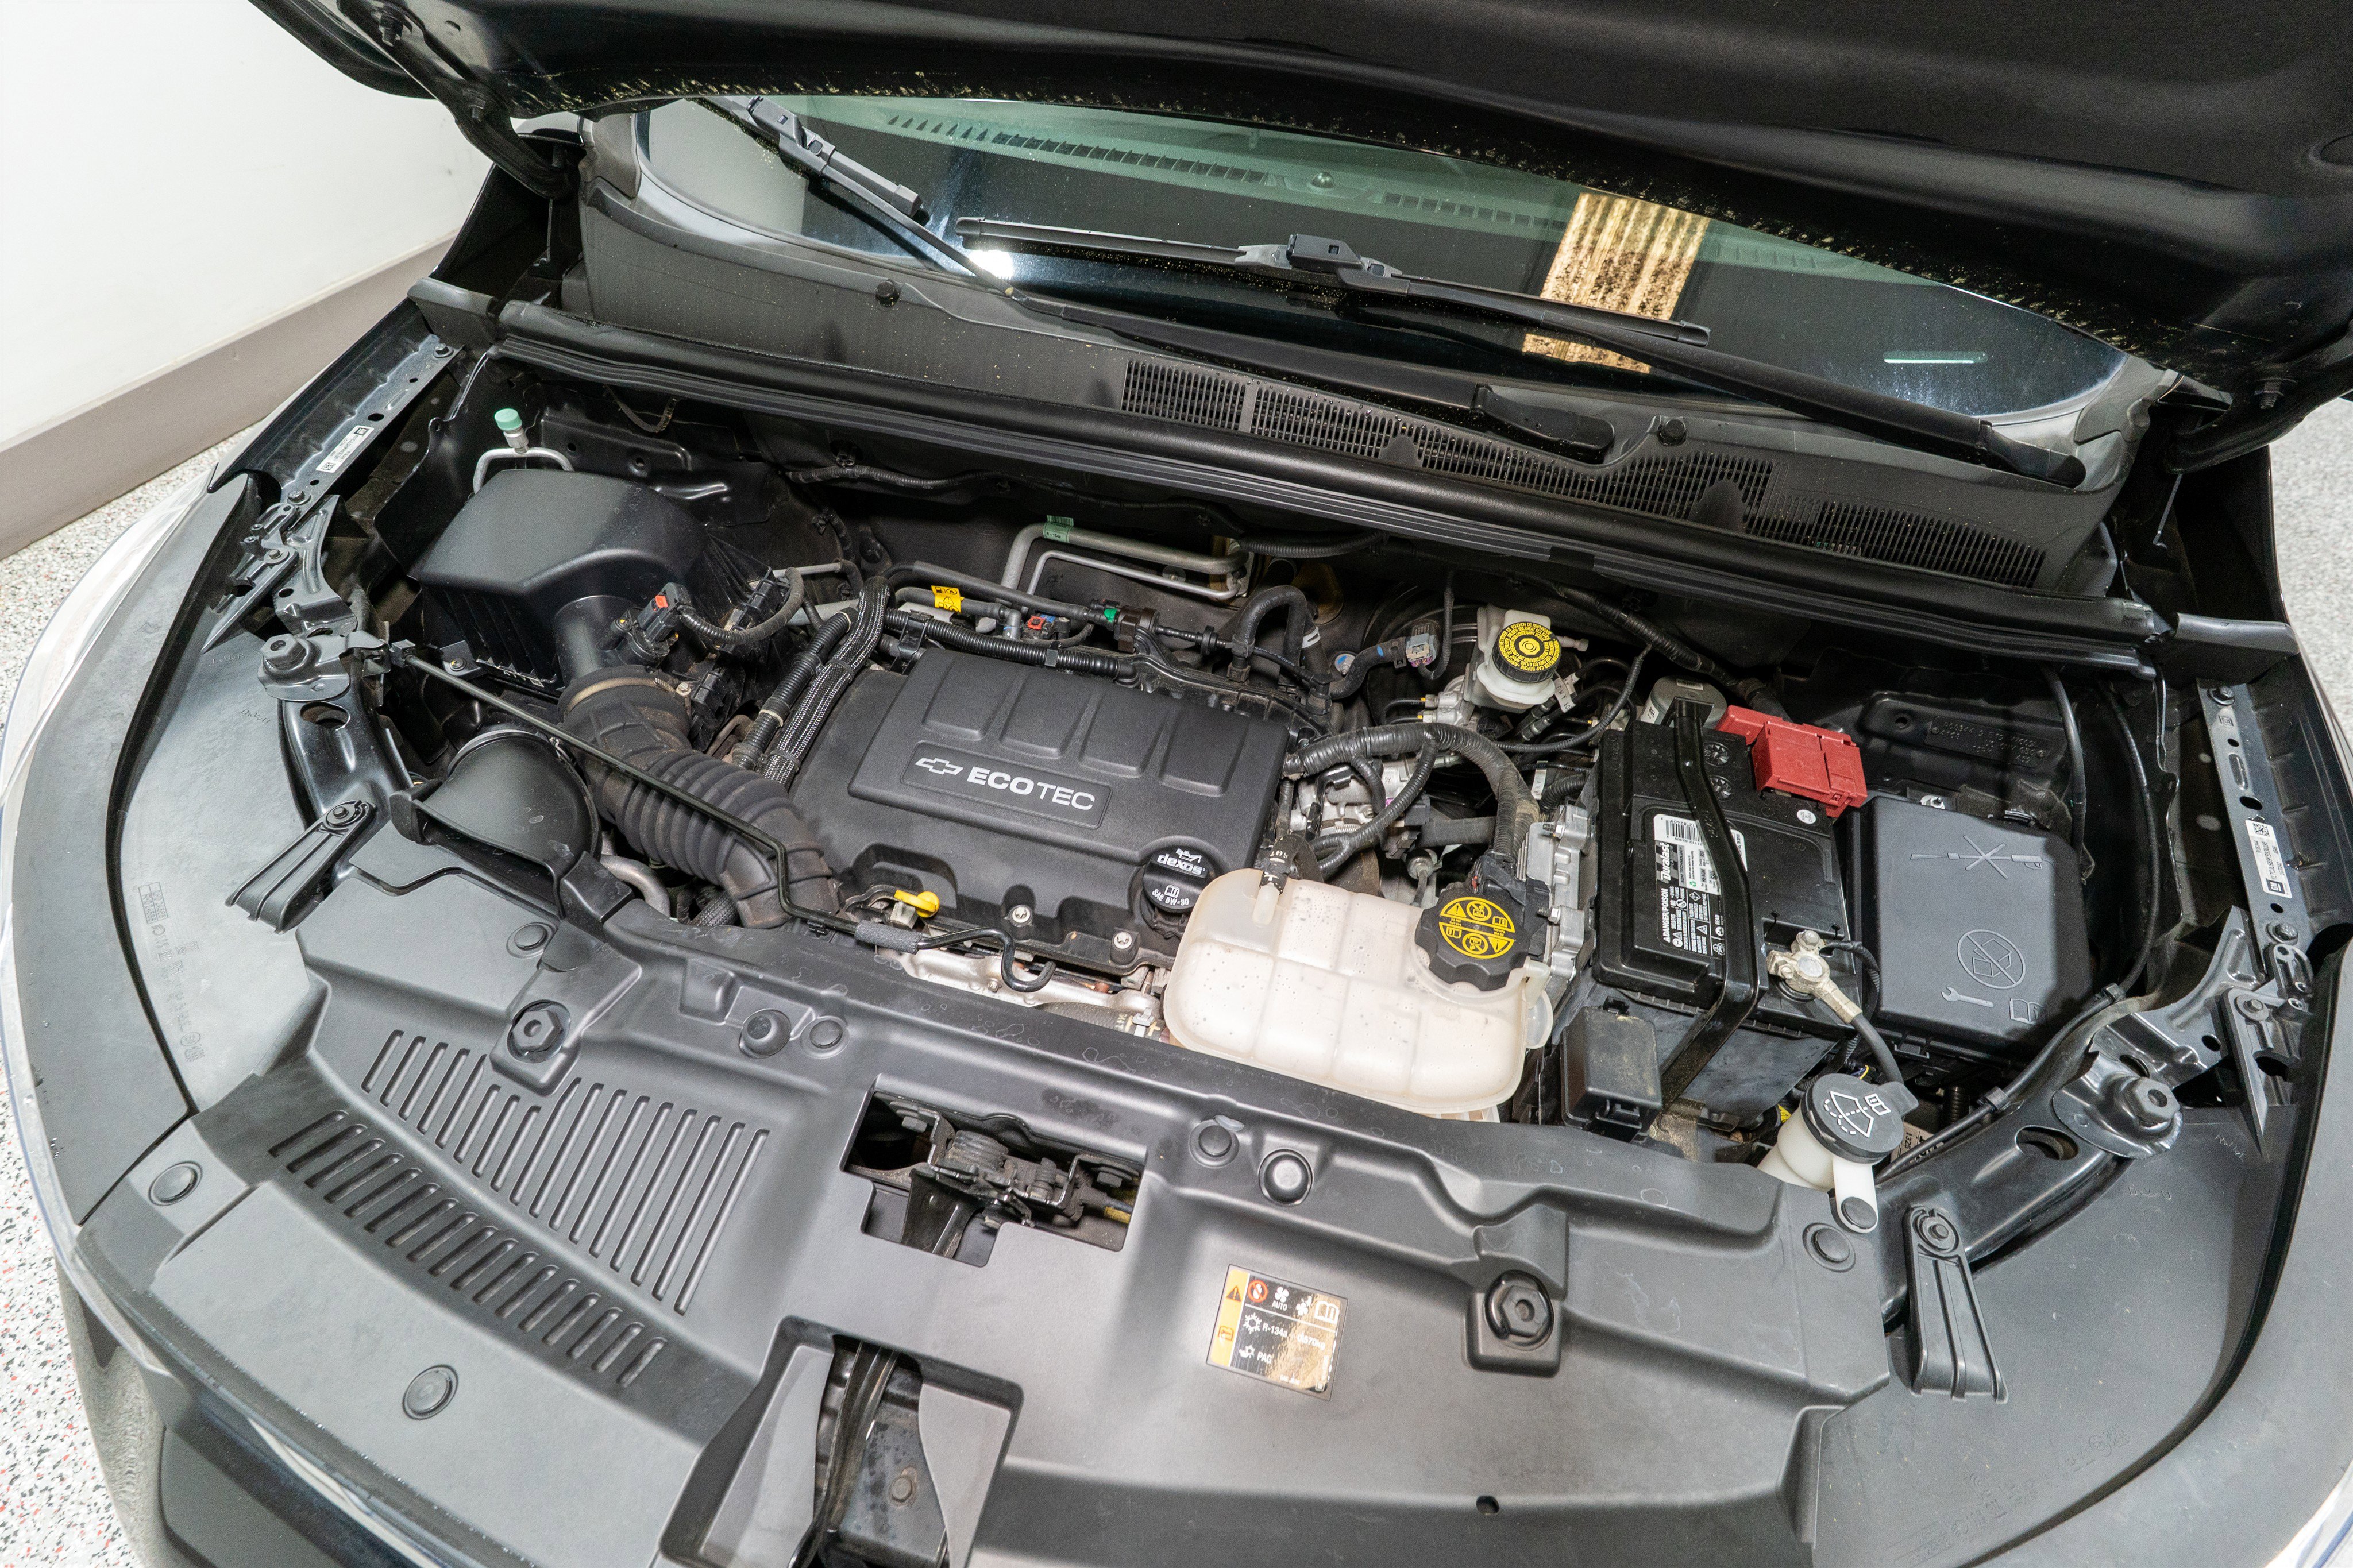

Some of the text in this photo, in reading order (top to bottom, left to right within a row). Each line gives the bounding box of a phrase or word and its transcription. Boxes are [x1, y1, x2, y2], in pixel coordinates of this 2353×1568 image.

[967, 767, 1096, 810] ECOTEC
[1660, 841, 1671, 881] Duralast
[1152, 889, 1165, 901] SAE
[1271, 1300, 1288, 1311] AUTO
[1262, 1322, 1288, 1338] R-134a
[1257, 1351, 1272, 1364] PAG
